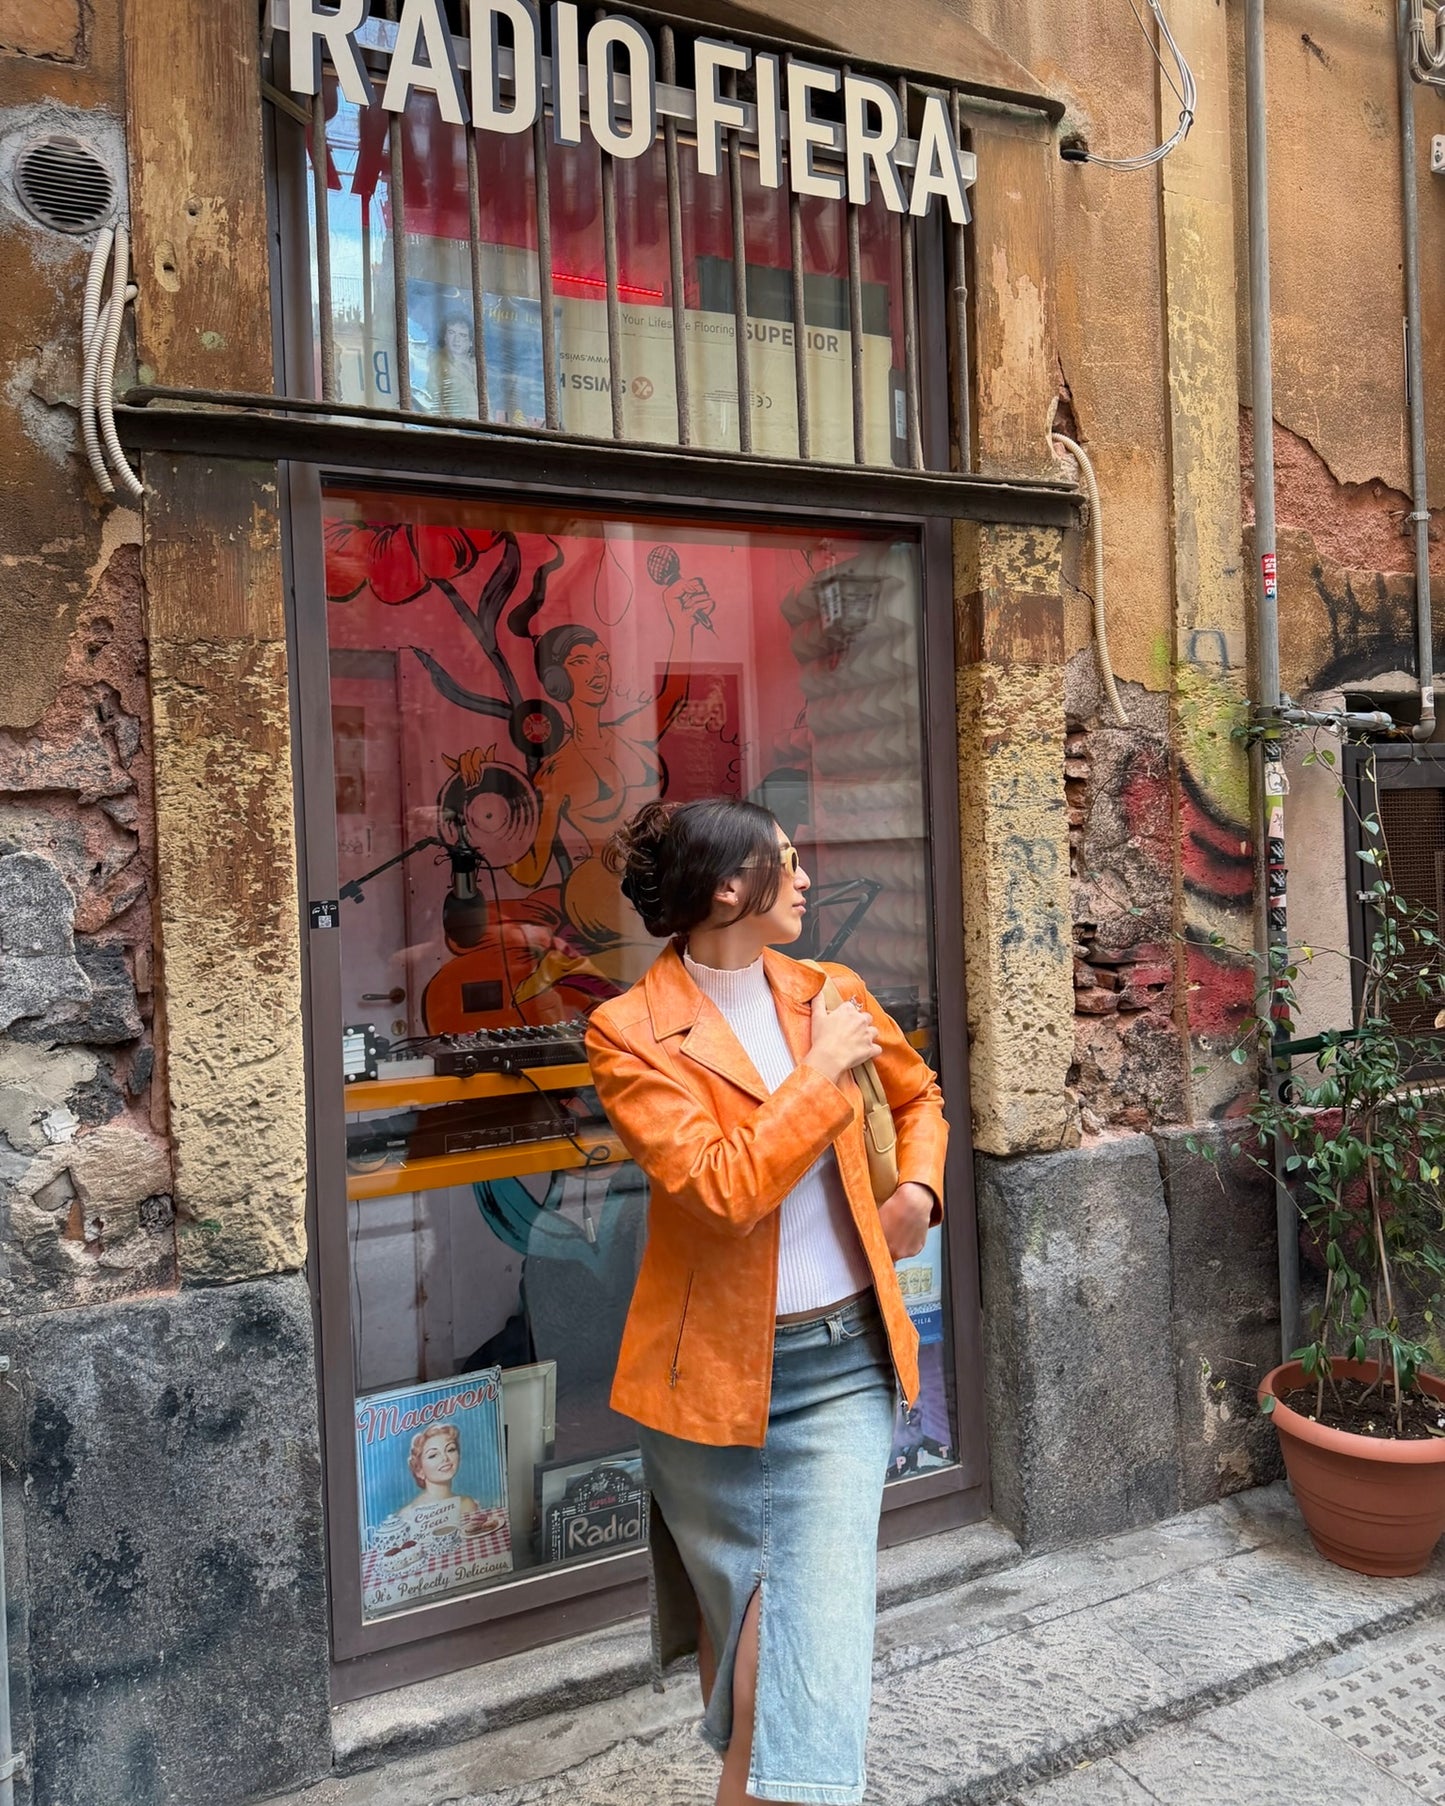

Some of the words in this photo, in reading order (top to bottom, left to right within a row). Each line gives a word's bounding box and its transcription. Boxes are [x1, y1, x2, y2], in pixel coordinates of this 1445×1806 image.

[289, 0, 655, 159] RADIO
[694, 36, 972, 225] FIERA
[622, 313, 644, 326] Your
[648, 316, 691, 331] Lifese
[694, 321, 735, 338] Flooring
[746, 322, 839, 353] SUPEIOR
[356, 1382, 498, 1445] Macaron
[415, 1503, 456, 1523] Cream
[420, 1516, 449, 1531] Teas
[568, 1513, 641, 1551] Radio
[372, 1588, 392, 1604] It's
[397, 1572, 450, 1597] Perfectly
[454, 1560, 508, 1581] Delicious
